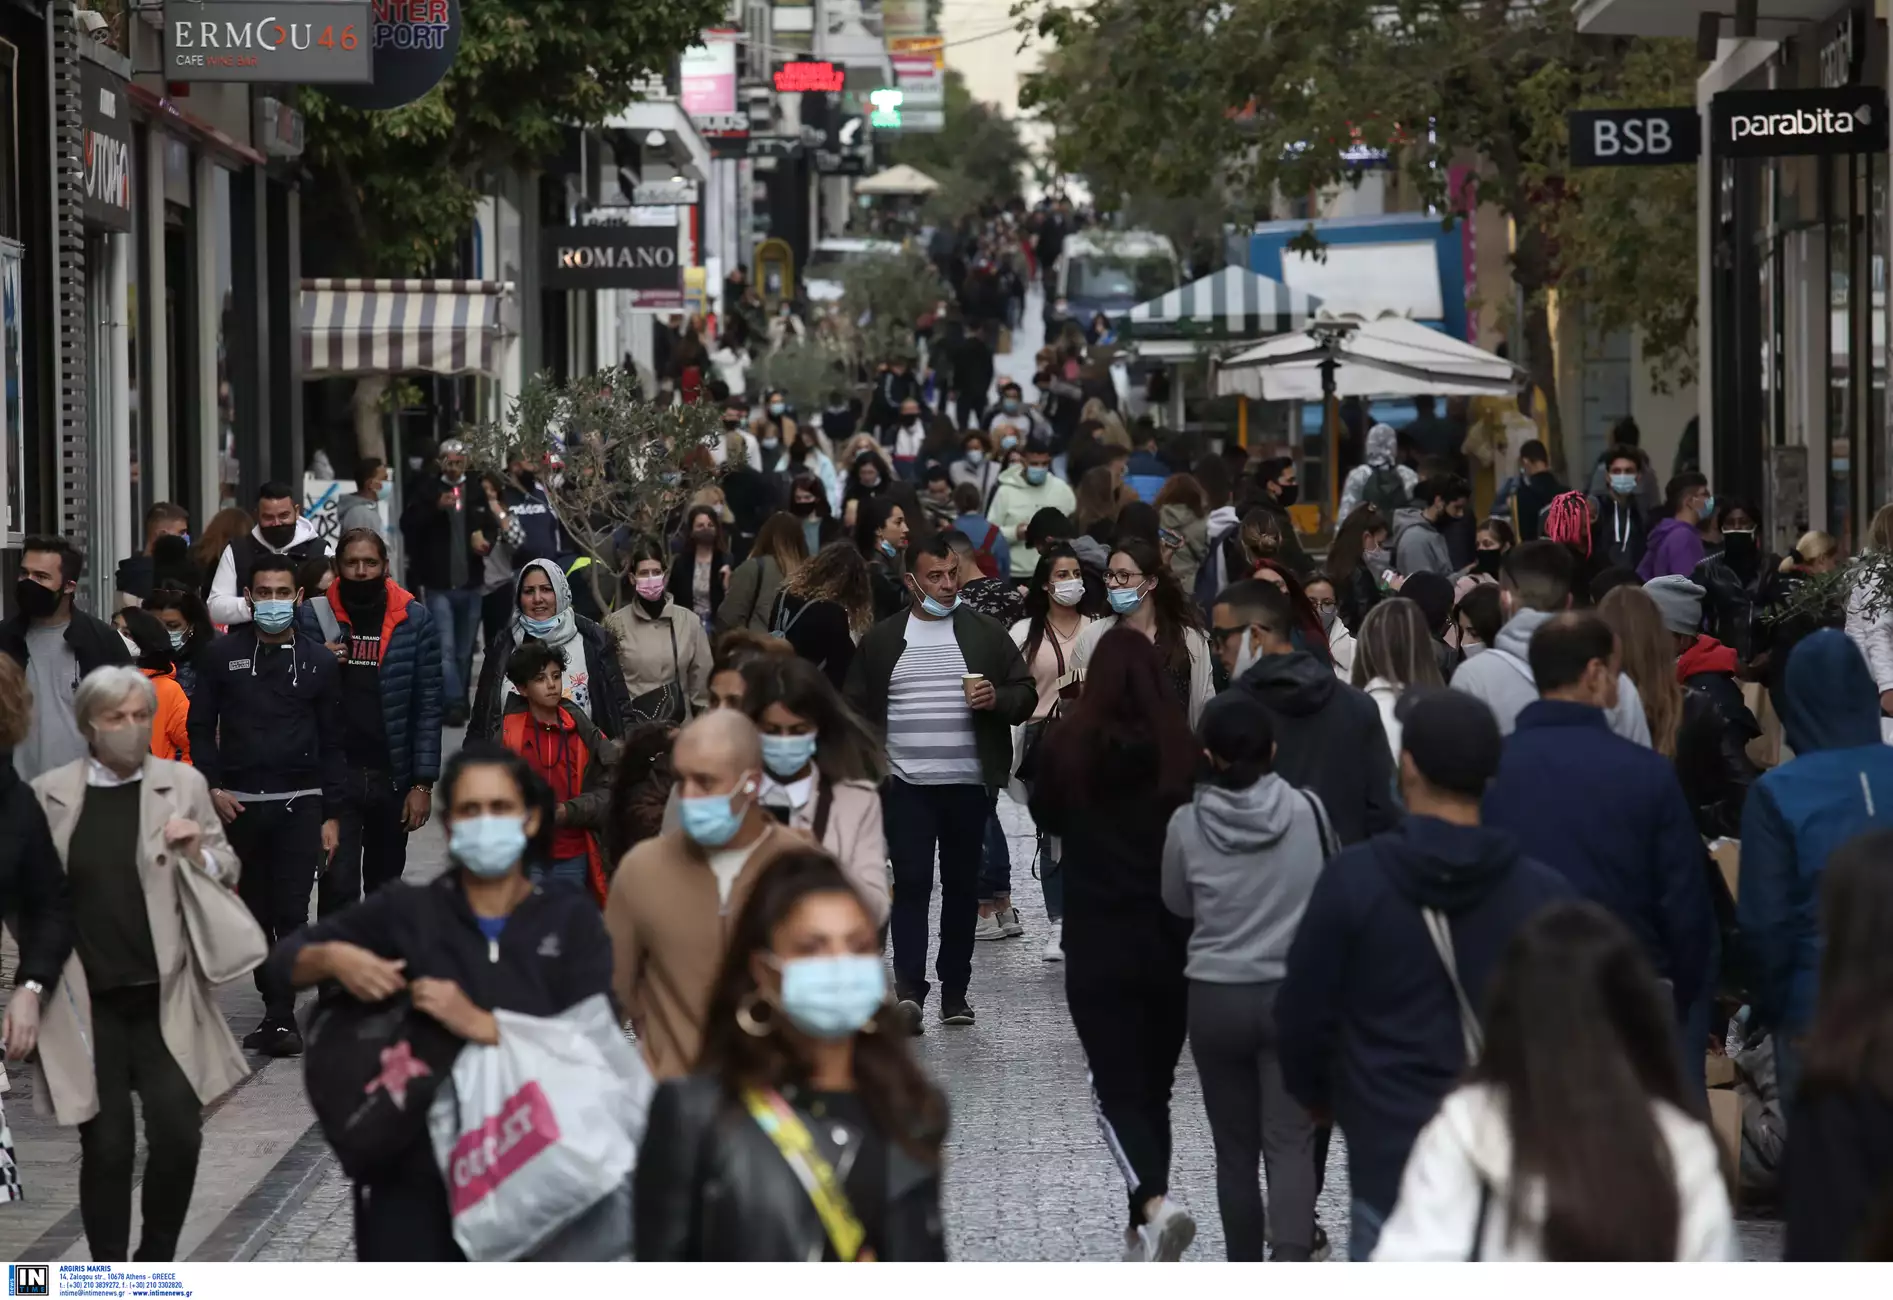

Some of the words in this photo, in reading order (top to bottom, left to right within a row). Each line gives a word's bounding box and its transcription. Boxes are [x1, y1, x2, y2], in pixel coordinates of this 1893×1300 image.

[371, 0, 450, 23] NTER
[174, 16, 312, 51] ERMOU
[316, 25, 359, 51] 46
[175, 54, 204, 67] CAFE
[206, 55, 233, 67] WINE
[237, 55, 257, 67] BAR
[1593, 118, 1673, 157] BSB
[1730, 108, 1854, 142] parabita
[557, 246, 675, 269] ROMANO
